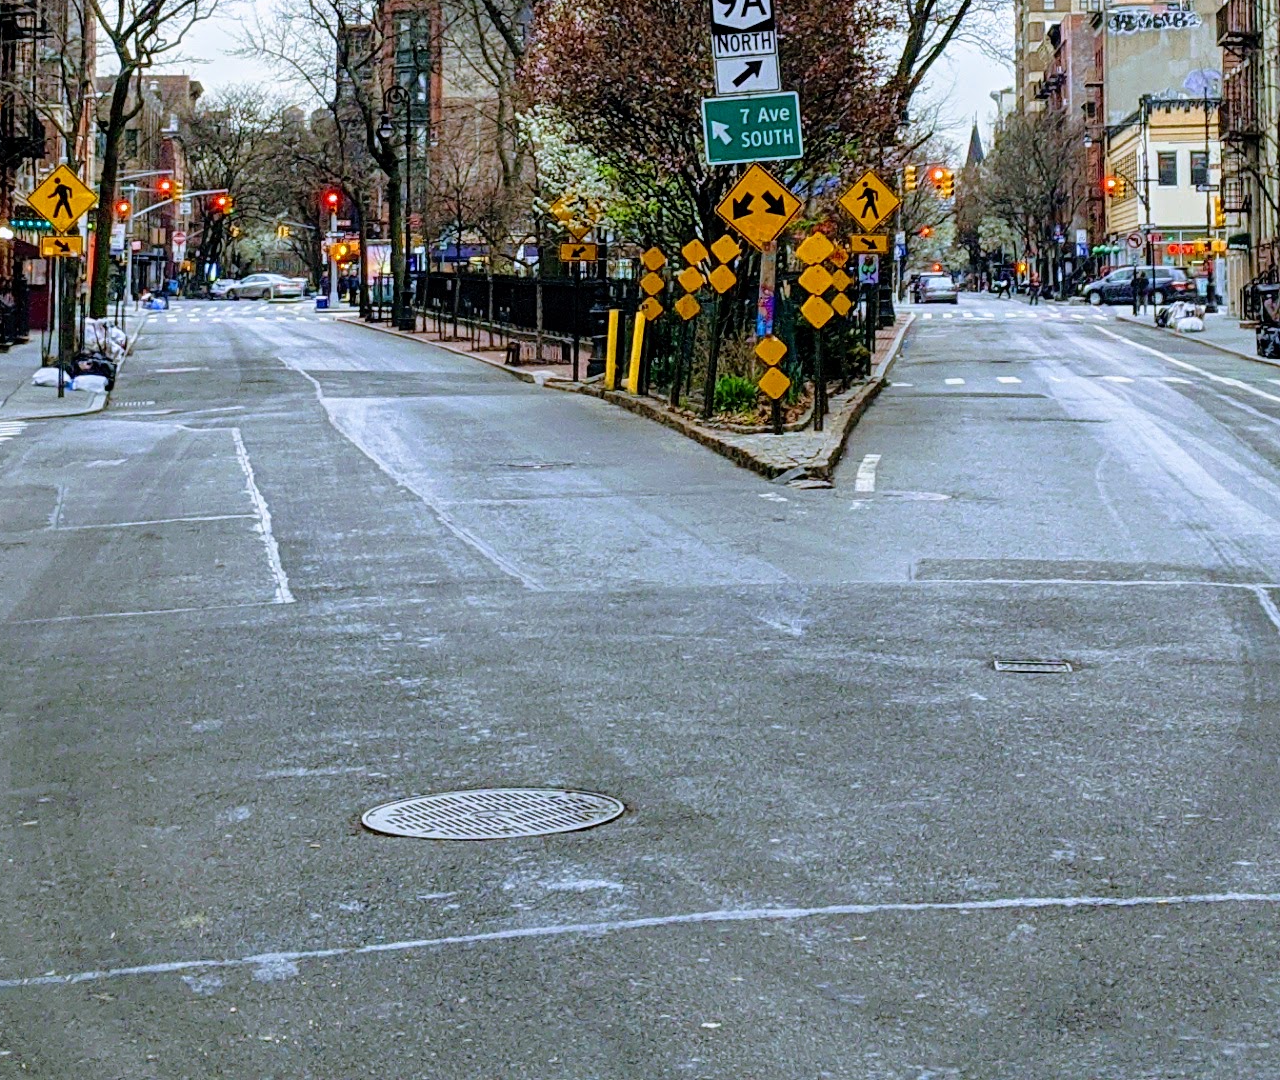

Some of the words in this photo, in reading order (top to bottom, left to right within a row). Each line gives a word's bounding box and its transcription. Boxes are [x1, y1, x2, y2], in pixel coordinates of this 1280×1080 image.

[716, 31, 772, 54] NORTH
[739, 107, 750, 124] 7
[757, 106, 790, 122] Ave
[741, 128, 794, 148] SOUTH
